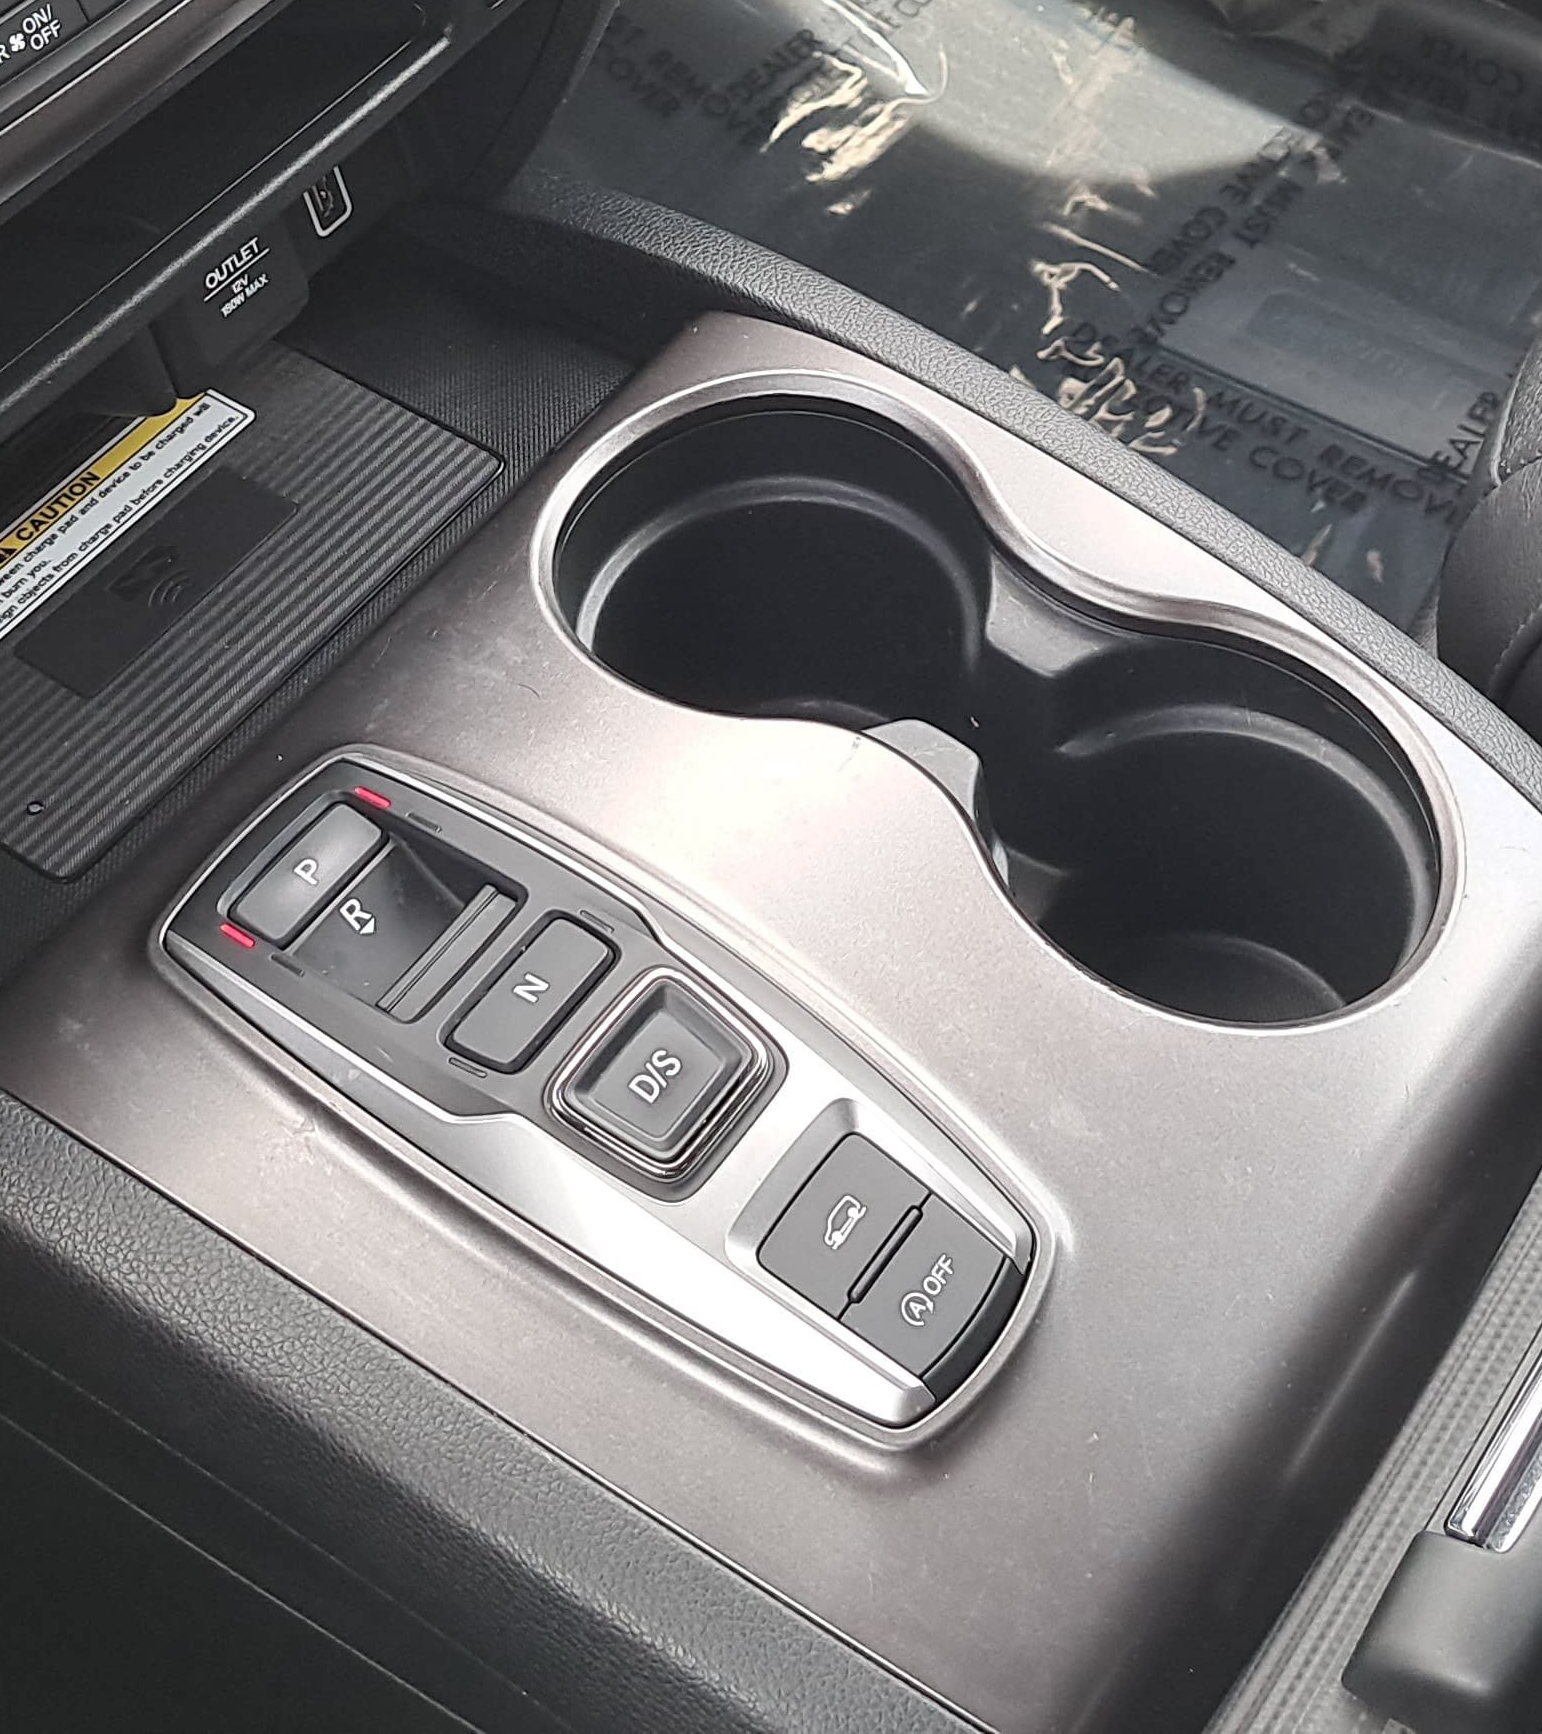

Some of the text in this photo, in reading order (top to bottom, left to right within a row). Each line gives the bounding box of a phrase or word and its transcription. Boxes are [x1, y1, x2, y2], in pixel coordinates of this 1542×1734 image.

[22, 3, 53, 37] ON/
[30, 20, 61, 52] OFF
[204, 236, 260, 290] OUTLET
[1205, 381, 1311, 452] MUST
[22, 533, 58, 562] charge
[57, 515, 77, 533] pad
[78, 497, 97, 515] and
[97, 471, 130, 498] device
[129, 461, 141, 471] to
[140, 449, 155, 461] be
[154, 417, 194, 449] charged
[194, 403, 210, 417] will
[1246, 437, 1368, 518] COVER
[16, 471, 101, 542] CAUTION
[17, 572, 54, 605] objects
[52, 552, 77, 572] from
[77, 523, 113, 552] charge
[112, 504, 131, 523] pad
[131, 477, 163, 505] before
[162, 442, 205, 478] charging
[203, 414, 238, 442] device.
[1, 577, 27, 597] burn
[294, 856, 321, 887] P
[339, 898, 371, 933] R
[512, 973, 549, 1004] N
[628, 1049, 682, 1105] D/S
[923, 1253, 954, 1296] OFF
